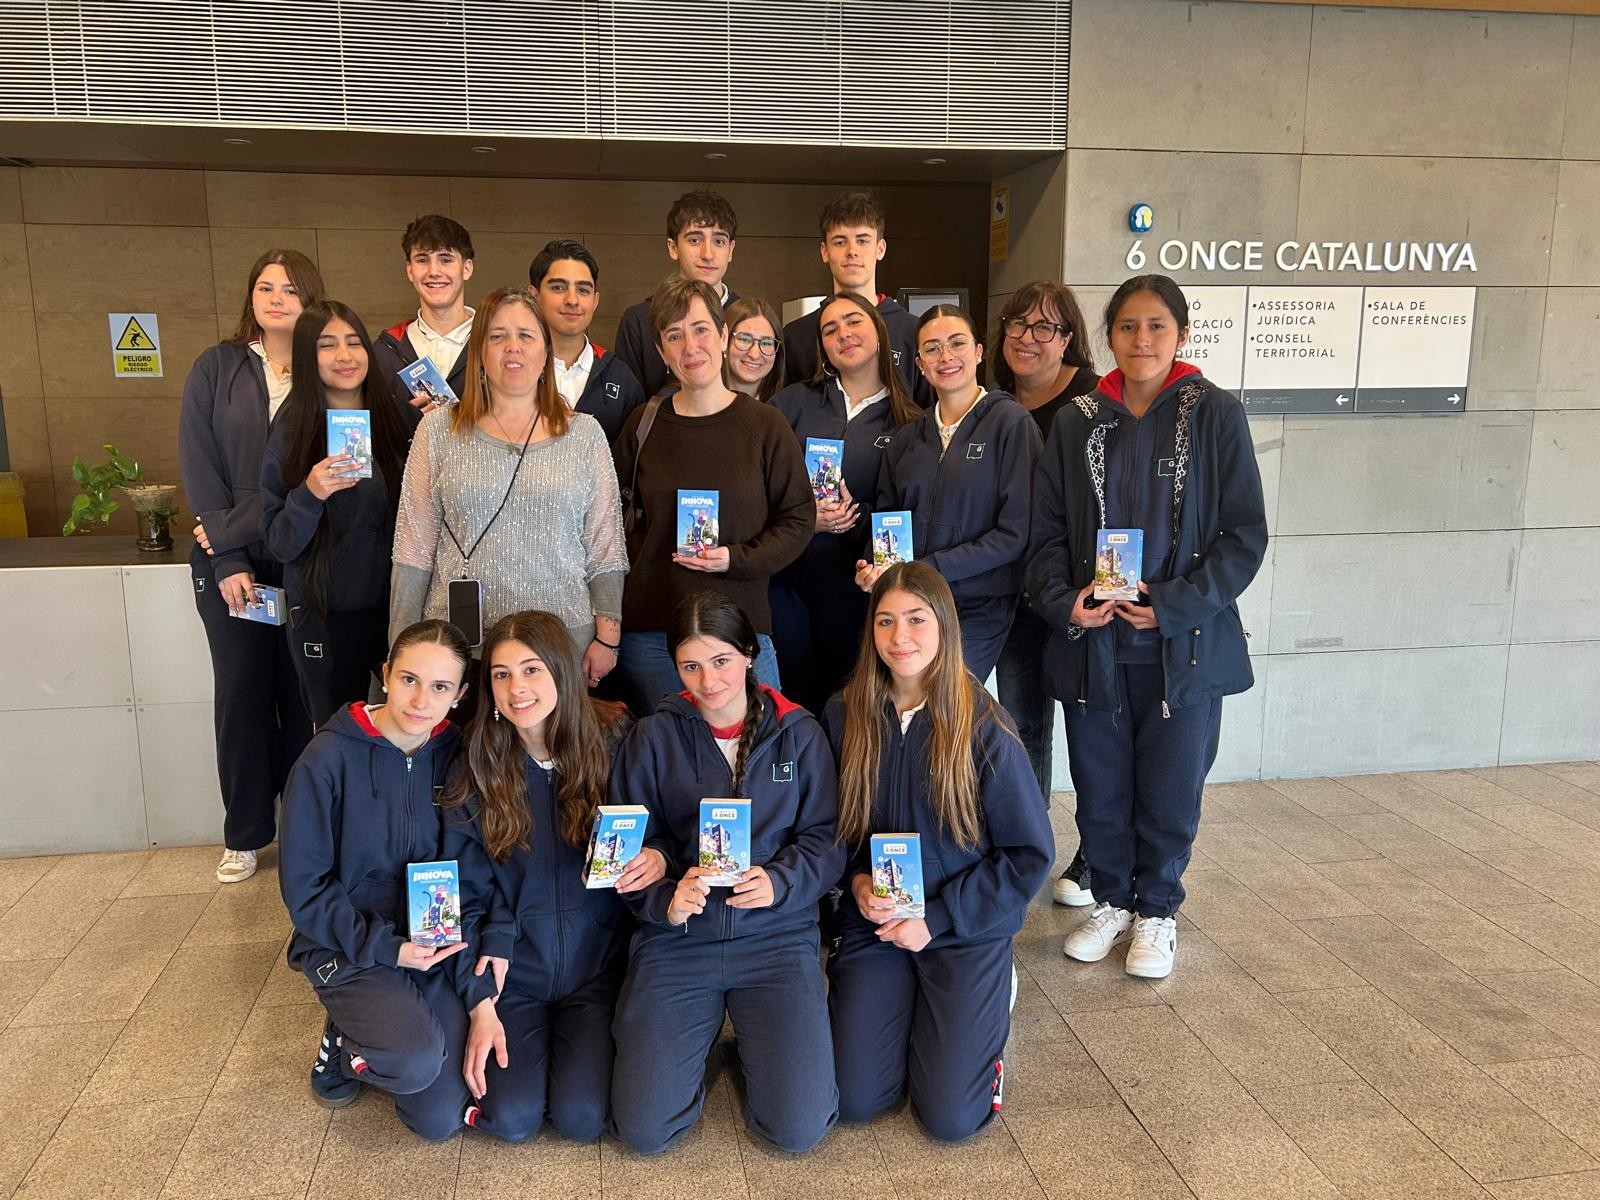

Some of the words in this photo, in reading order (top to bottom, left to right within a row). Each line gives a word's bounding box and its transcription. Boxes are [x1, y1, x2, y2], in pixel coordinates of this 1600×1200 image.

[1126, 240, 1146, 270] 6
[1159, 240, 1264, 271] ONCE
[1275, 241, 1478, 272] CATALUNYA
[1257, 301, 1335, 311] ASSESSORIA
[1373, 301, 1404, 311] SALA
[1410, 301, 1426, 311] DE
[1257, 315, 1316, 326] JURÍDICA
[1372, 313, 1467, 325] CONFERÈNCIES
[1256, 333, 1313, 344] CONSELL
[1255, 349, 1336, 358] TERRITORIAL
[808, 443, 839, 455] INNOVA
[680, 496, 715, 506] INNOVA
[413, 870, 455, 882] INNOVA
